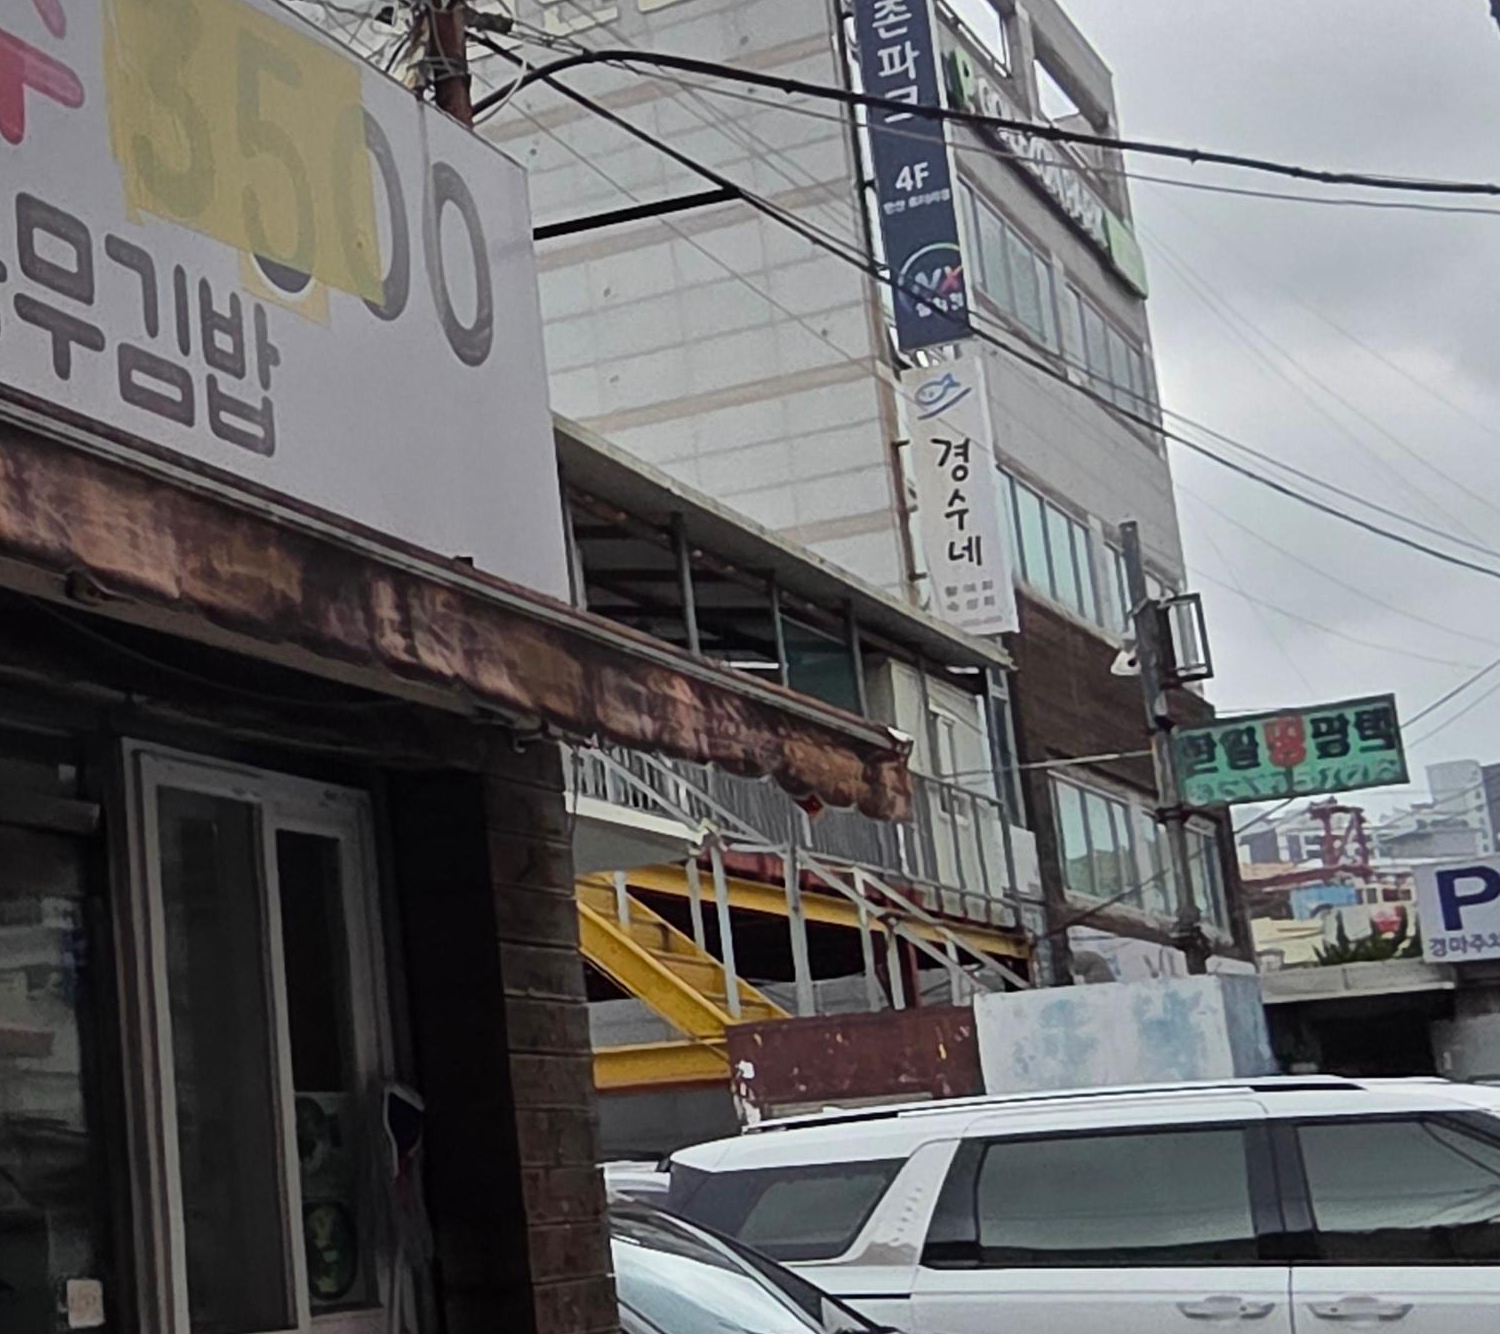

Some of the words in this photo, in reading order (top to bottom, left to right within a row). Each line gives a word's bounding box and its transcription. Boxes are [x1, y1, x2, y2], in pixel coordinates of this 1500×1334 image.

[894, 161, 930, 192] 4F
[930, 436, 983, 567] 경수네
[1436, 865, 1500, 932] P
